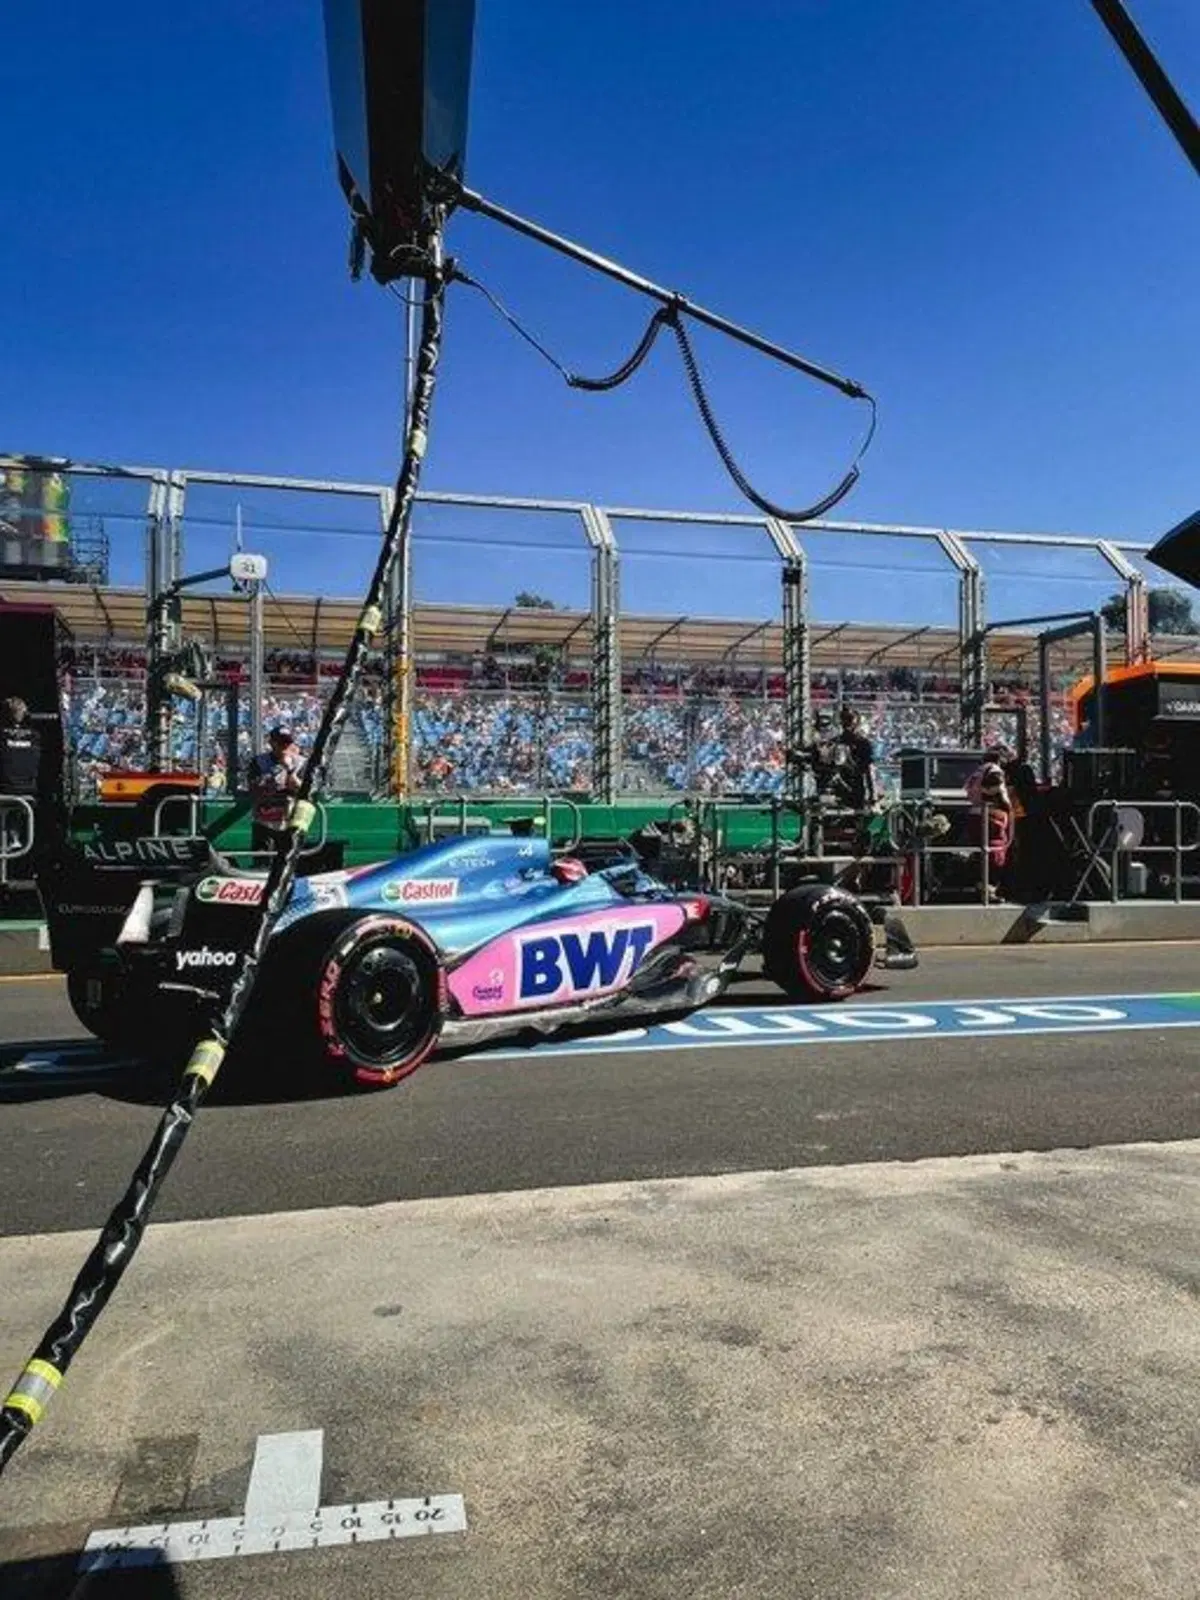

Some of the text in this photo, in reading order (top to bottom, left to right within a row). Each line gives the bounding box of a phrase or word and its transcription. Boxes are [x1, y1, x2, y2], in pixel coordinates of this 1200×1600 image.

[84, 840, 194, 860] ALPINE
[219, 881, 262, 900] Cast
[403, 882, 454, 901] Castrol
[176, 945, 237, 971] yahoo
[520, 925, 653, 998] BWT
[570, 1004, 1127, 1043] aram
[340, 1517, 363, 1530] 10
[380, 1512, 404, 1525] 15
[414, 1507, 445, 1521] 20
[310, 1520, 323, 1533] 5
[188, 1533, 210, 1545] 10
